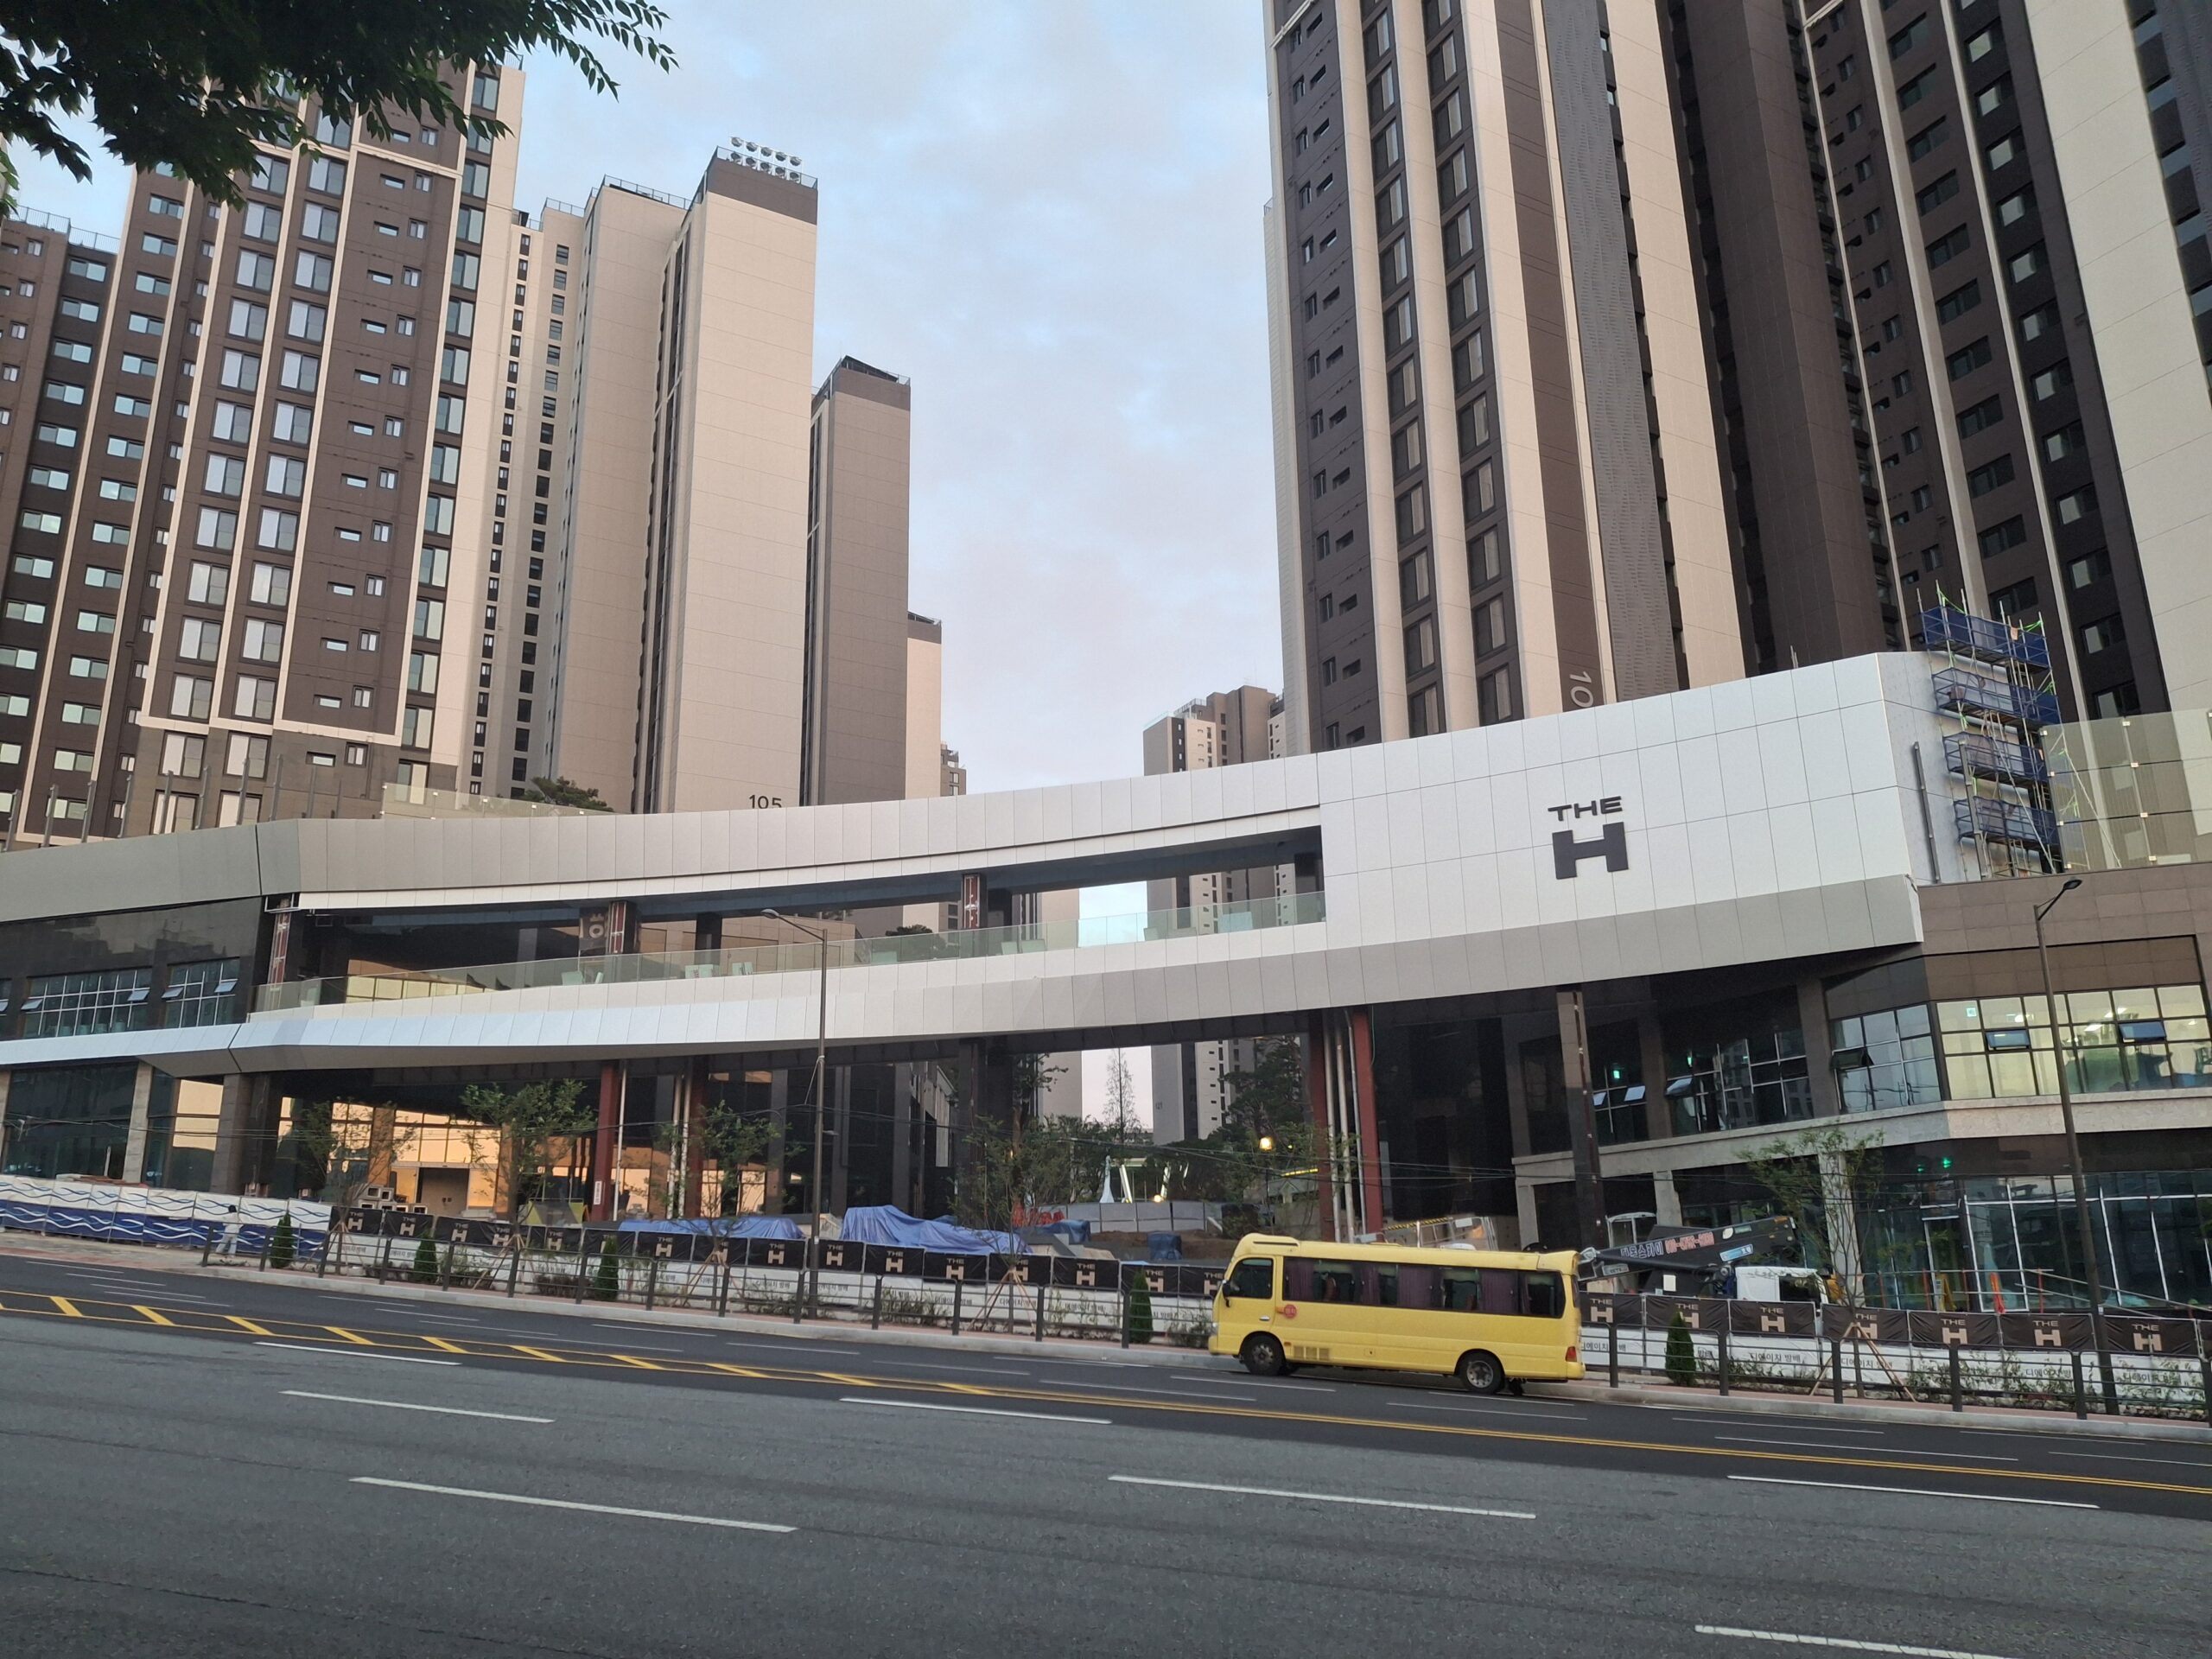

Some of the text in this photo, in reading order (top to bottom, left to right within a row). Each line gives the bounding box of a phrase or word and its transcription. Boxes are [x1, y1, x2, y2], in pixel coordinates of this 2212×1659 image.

[749, 794, 782, 809] 105
[1548, 796, 1623, 821] THE
[1552, 822, 1629, 880] H
[347, 1217, 363, 1230] H
[399, 1223, 415, 1236] H
[451, 1230, 467, 1242] H
[548, 1237, 562, 1250] H
[656, 1243, 672, 1257] H
[767, 1249, 785, 1265] H
[826, 1251, 843, 1266] H
[886, 1257, 903, 1273] H
[945, 1264, 964, 1280] H
[1076, 1270, 1096, 1286] H
[1146, 1277, 1164, 1293] H
[1590, 1306, 1613, 1323] H
[1761, 1315, 1785, 1332] H
[1942, 1327, 1967, 1344] H
[2034, 1329, 2062, 1346] H
[2133, 1332, 2163, 1351] H
